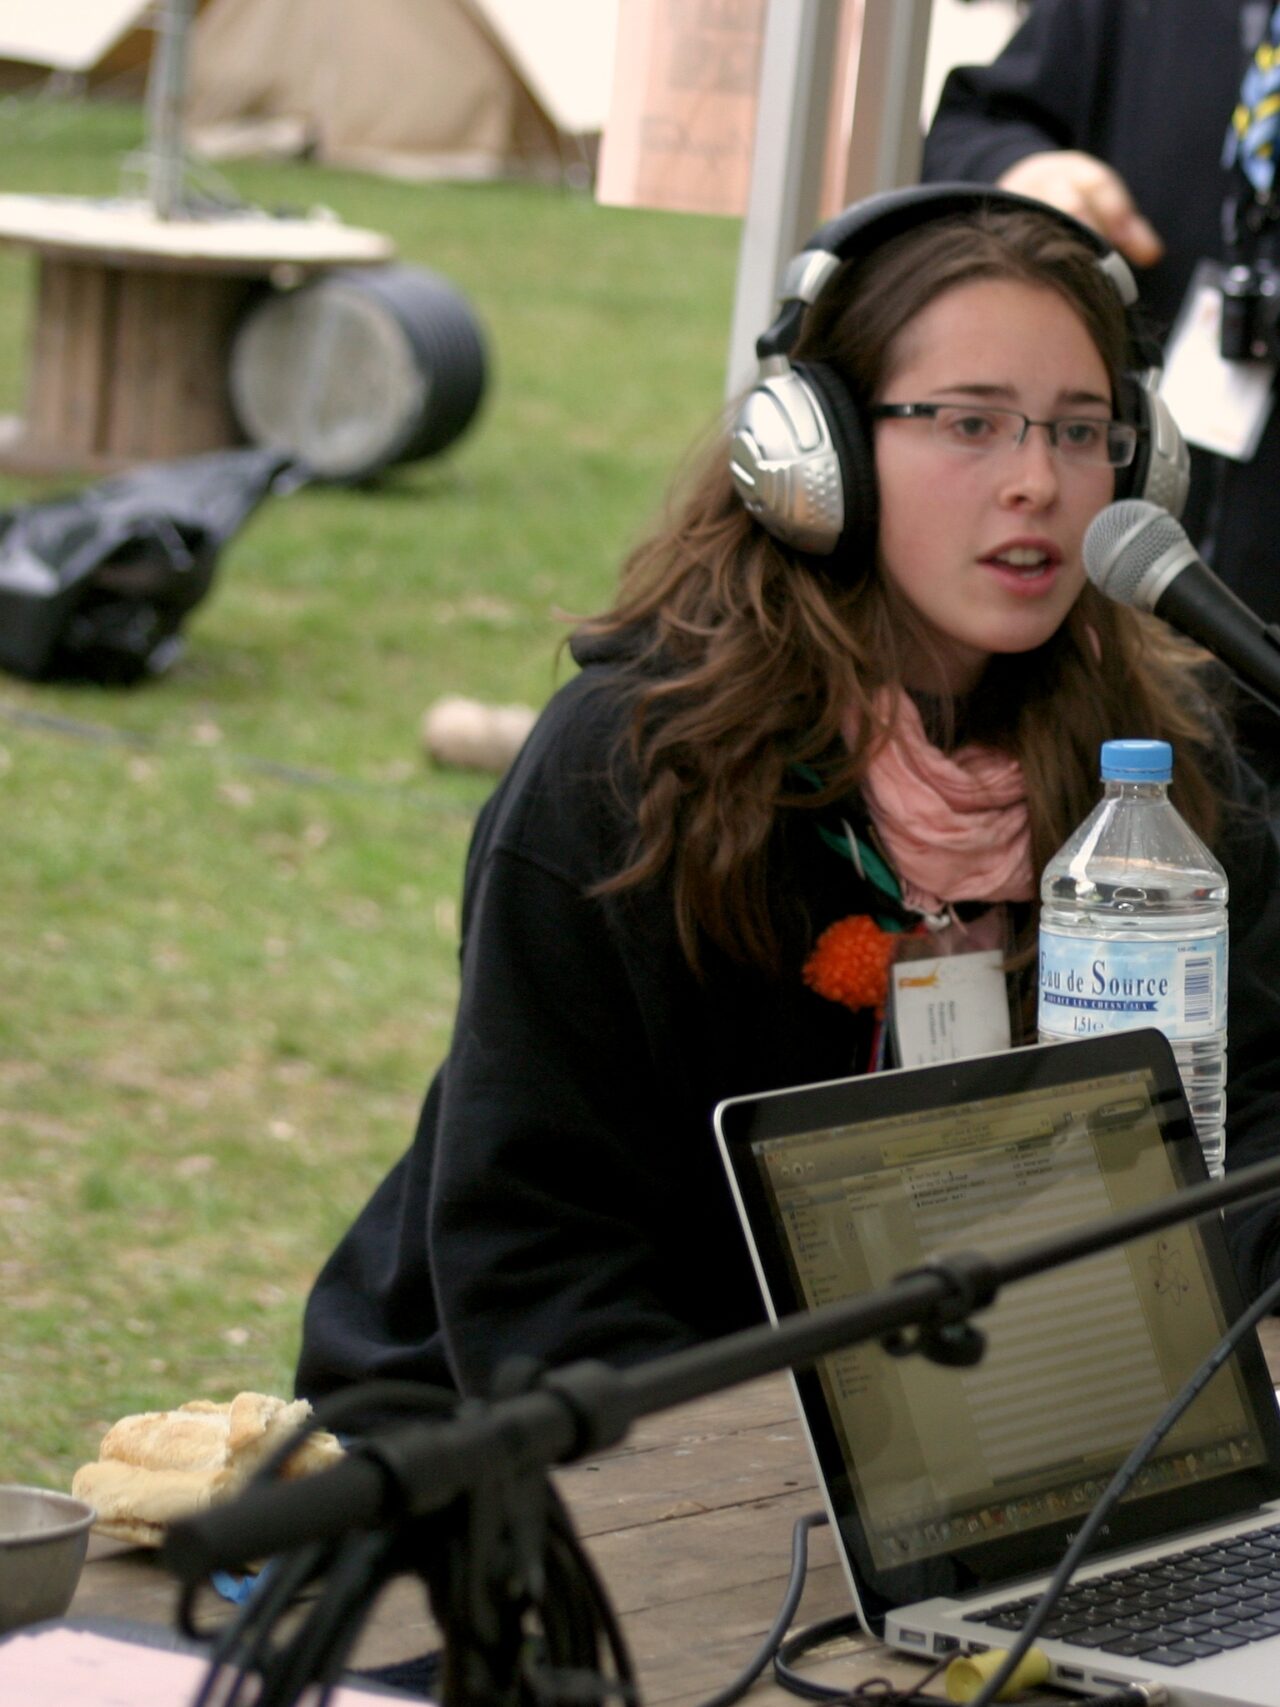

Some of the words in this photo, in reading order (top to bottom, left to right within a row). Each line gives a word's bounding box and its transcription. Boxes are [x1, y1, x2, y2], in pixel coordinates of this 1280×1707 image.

[1067, 968, 1084, 993] de
[1091, 960, 1168, 997] Source
[1073, 997, 1088, 1008] LES
